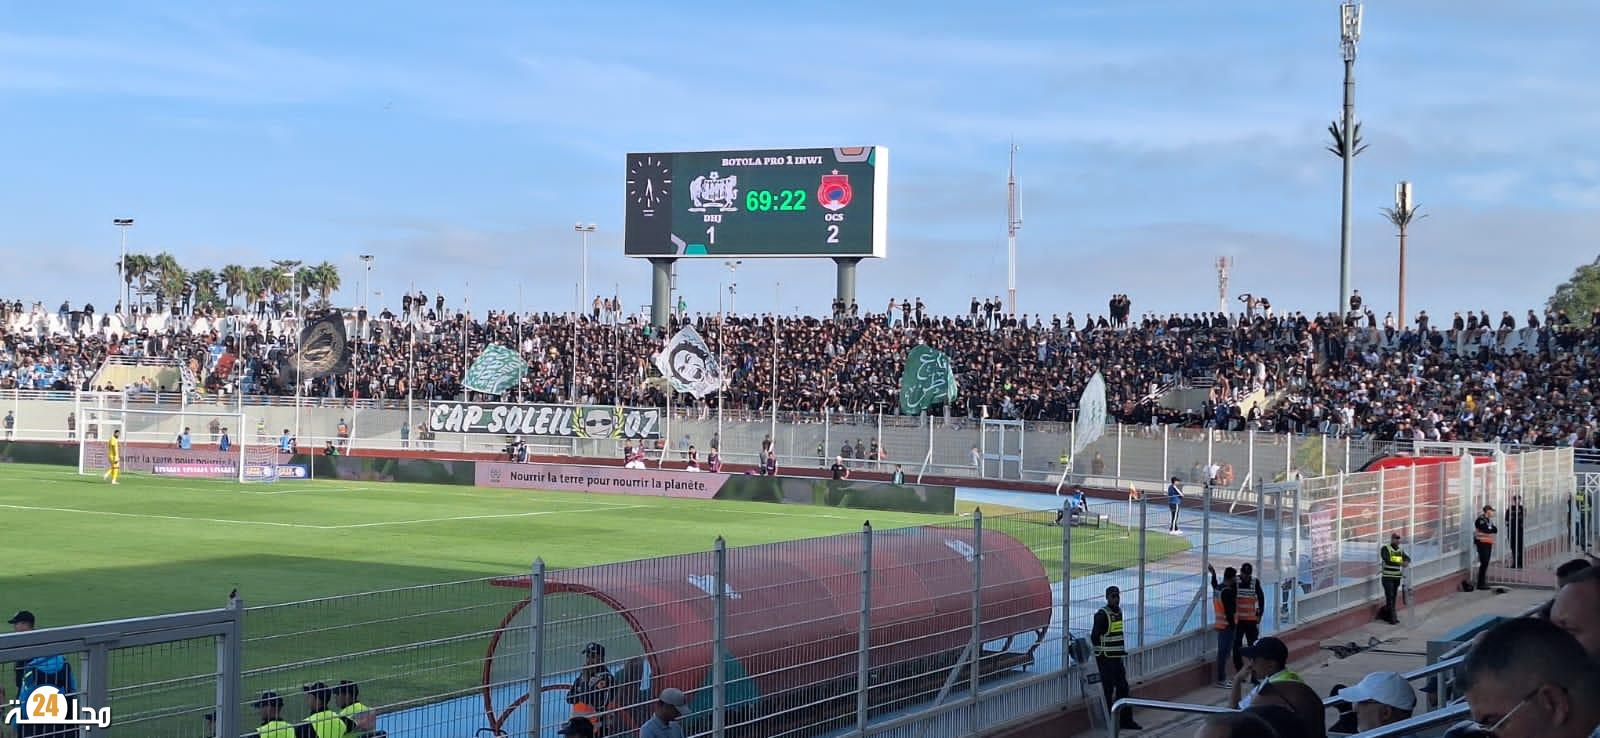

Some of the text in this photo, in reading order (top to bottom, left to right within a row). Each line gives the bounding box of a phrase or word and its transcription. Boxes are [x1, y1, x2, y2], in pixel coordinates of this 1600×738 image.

[721, 156, 824, 167] BOTOLA PRO 1 INWI
[745, 190, 807, 212] 69:22
[703, 214, 723, 224] DHJ
[824, 213, 845, 222] OCS
[706, 225, 715, 244] 1
[826, 225, 840, 244] 2
[431, 403, 482, 432] CAP
[488, 405, 572, 436] SOLEIL
[510, 471, 545, 482] Nourrir
[548, 471, 557, 483] la
[560, 474, 584, 484] terre
[587, 476, 609, 488] pour
[613, 477, 648, 488] nourrir
[652, 478, 662, 488] la
